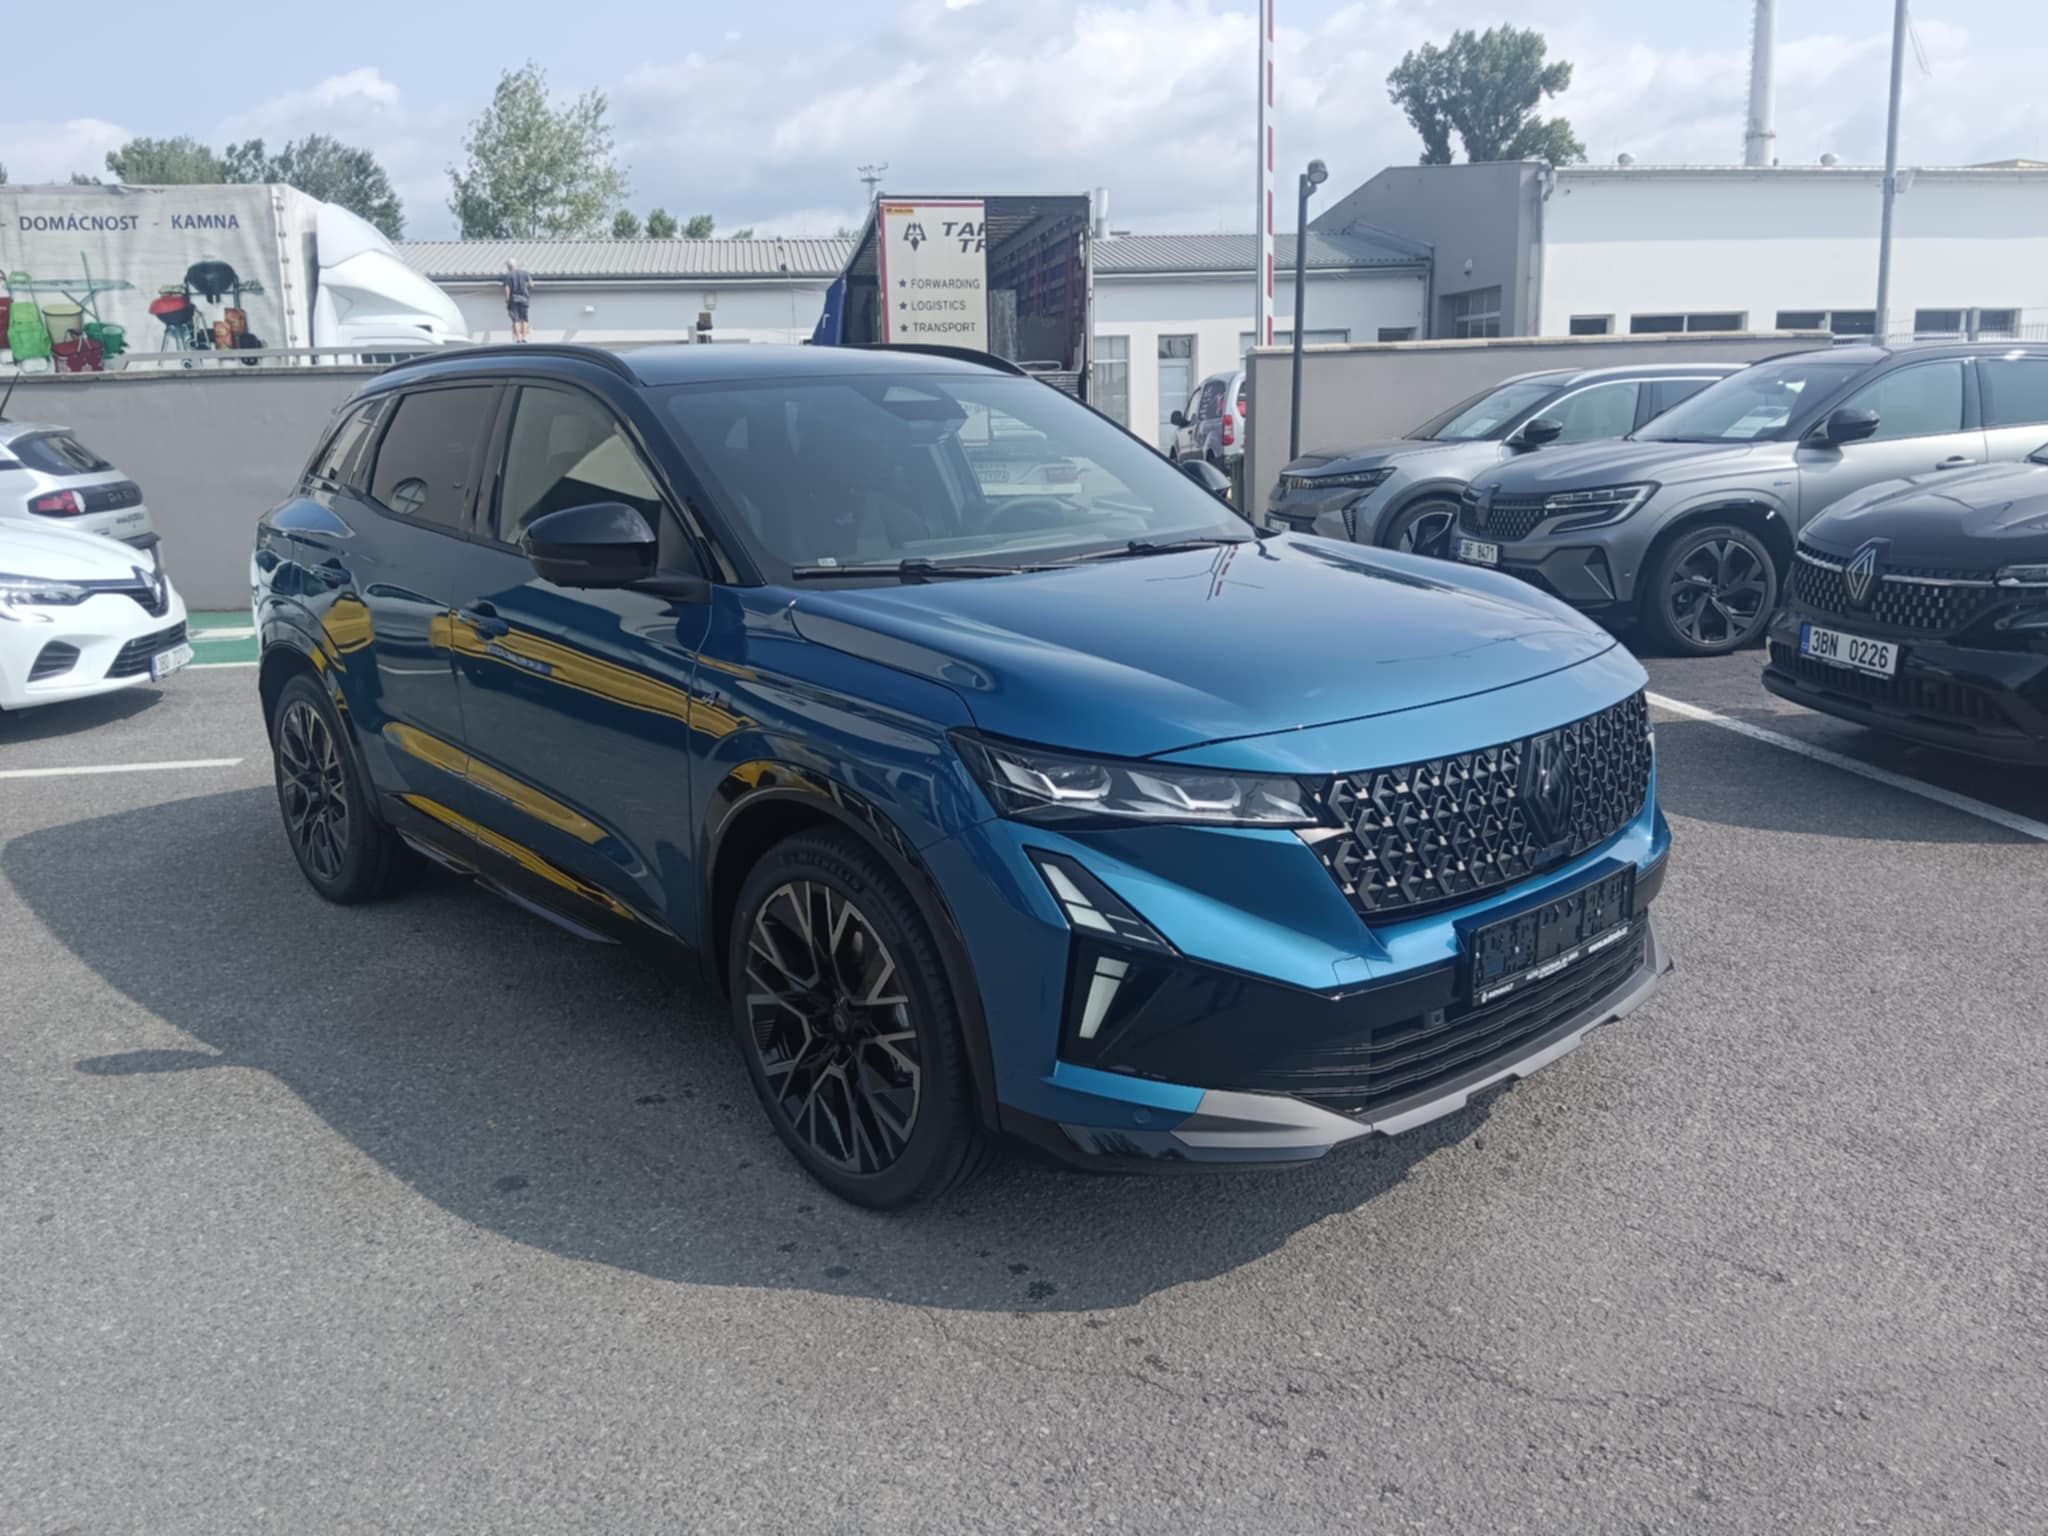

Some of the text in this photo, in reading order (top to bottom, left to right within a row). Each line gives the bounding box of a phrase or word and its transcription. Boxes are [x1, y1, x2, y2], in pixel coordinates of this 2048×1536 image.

[19, 213, 240, 231] DOMÁCNOST KAMNA
[910, 278, 980, 290] FORWARDING
[911, 299, 967, 311] LOGISTICS
[913, 321, 976, 333] TRANSPORT
[1811, 629, 1889, 669] 3BN 0226
